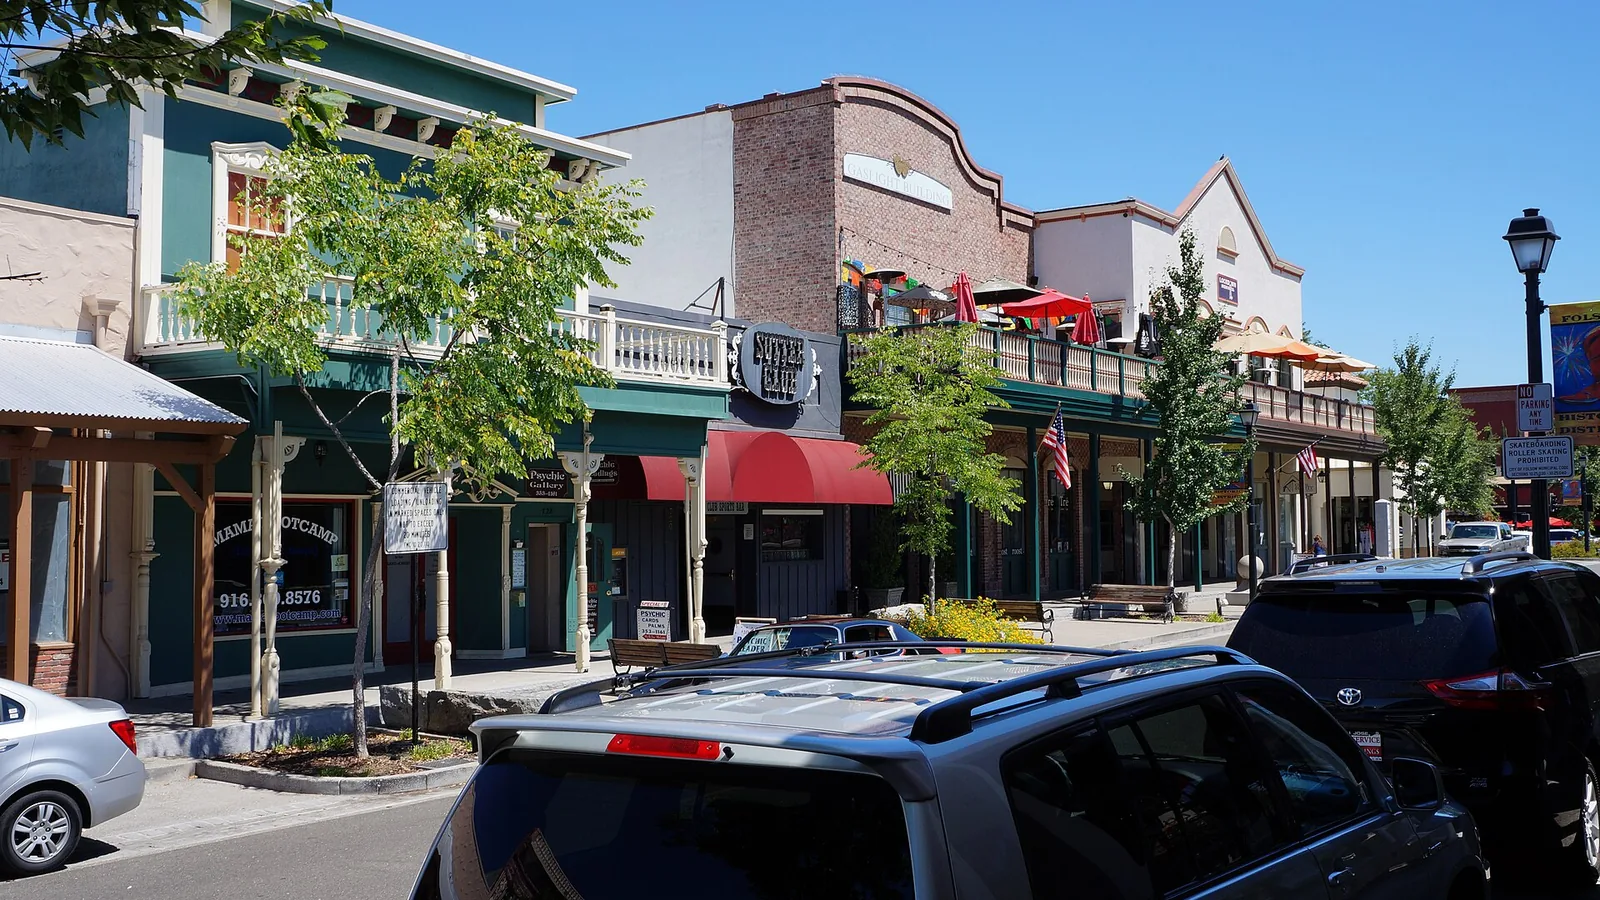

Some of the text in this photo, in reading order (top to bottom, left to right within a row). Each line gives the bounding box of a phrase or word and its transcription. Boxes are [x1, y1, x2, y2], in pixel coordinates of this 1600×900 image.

[848, 163, 950, 206] GASLIGHT BUILDING
[1520, 386, 1532, 397] NO
[1520, 400, 1550, 409] PARKING
[1529, 410, 1541, 418] ANY
[1529, 418, 1542, 426] TIME
[1509, 440, 1567, 449] SKATEBOARDING
[1508, 448, 1568, 457] ROLLER SKATING
[1517, 456, 1560, 464] PROHIBITED
[530, 470, 565, 481] Psychic
[391, 486, 420, 495] COMMERCIAL
[529, 482, 564, 490] Gallery
[417, 520, 434, 528] EXCEED
[220, 590, 321, 608] 916..8576
[737, 636, 768, 645] PCHIC
[746, 645, 765, 653] ADER
[1355, 736, 1381, 744] ERVICE
